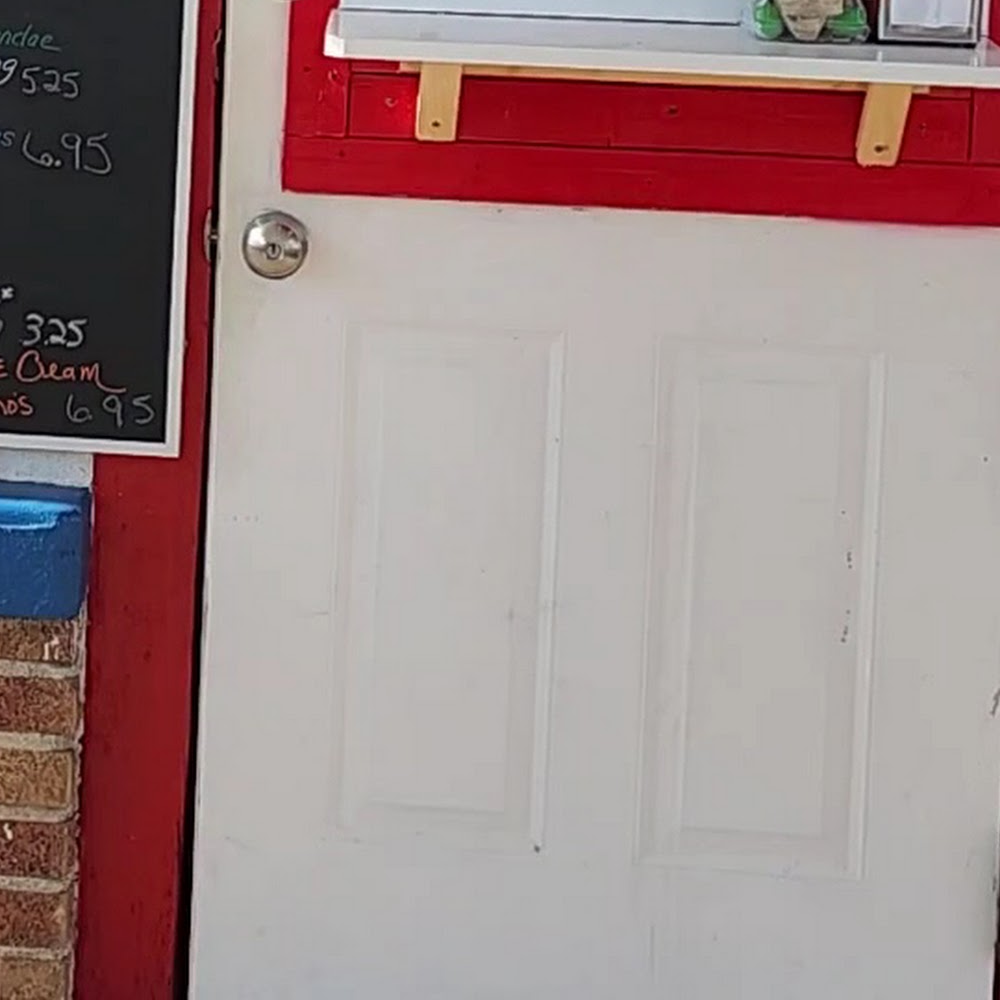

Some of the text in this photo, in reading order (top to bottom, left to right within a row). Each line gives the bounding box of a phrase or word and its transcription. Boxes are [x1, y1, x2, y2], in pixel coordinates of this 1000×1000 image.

[22, 132, 112, 175] 6.95
[22, 313, 88, 347] 3.25
[16, 350, 127, 394] Cream
